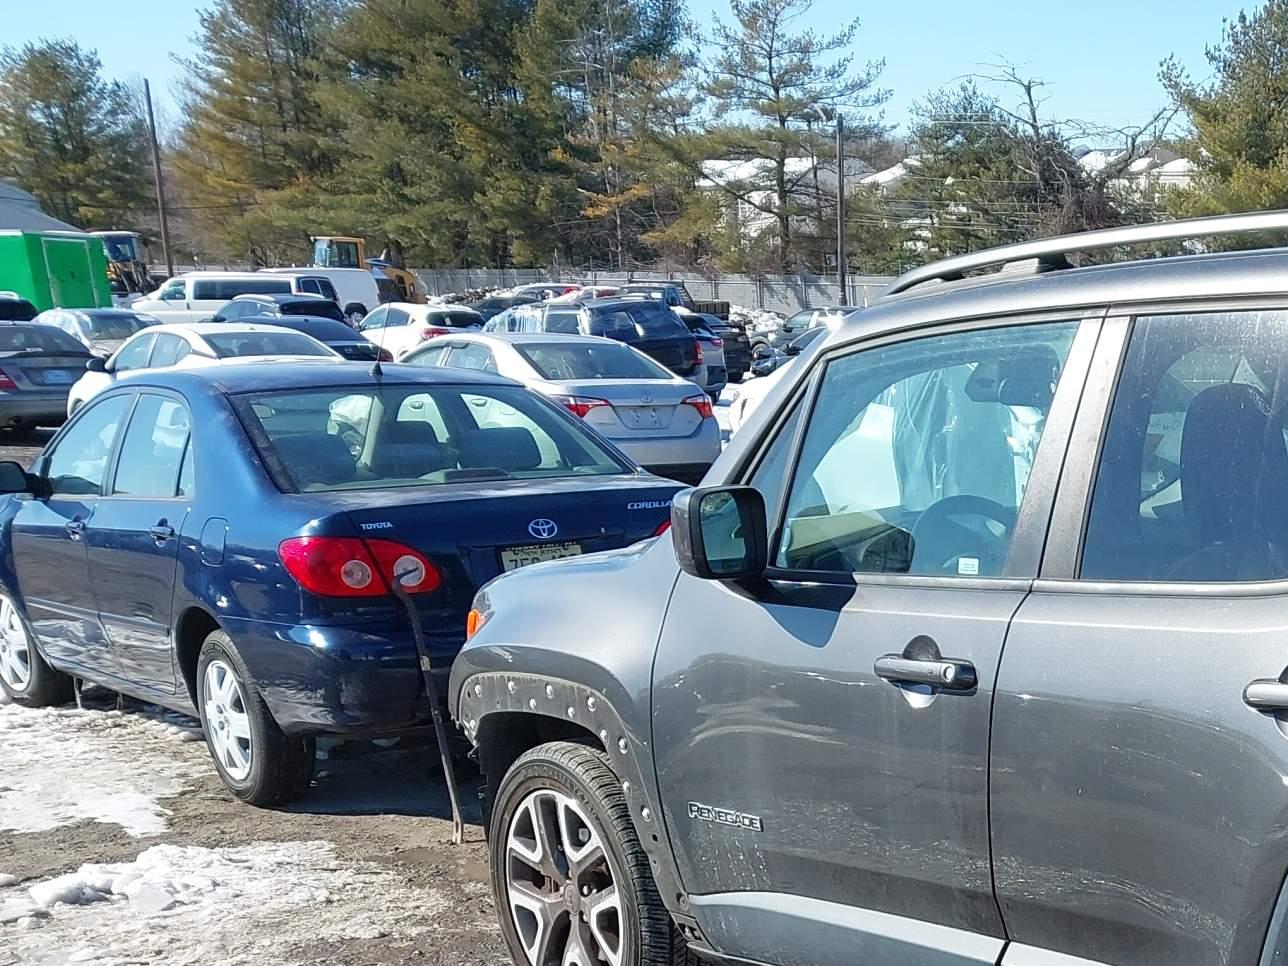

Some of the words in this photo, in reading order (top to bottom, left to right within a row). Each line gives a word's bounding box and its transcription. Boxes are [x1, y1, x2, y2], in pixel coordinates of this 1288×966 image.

[627, 500, 673, 510] COROLLA
[360, 521, 394, 530] TOYOTA
[687, 801, 763, 832] RENEGADE
